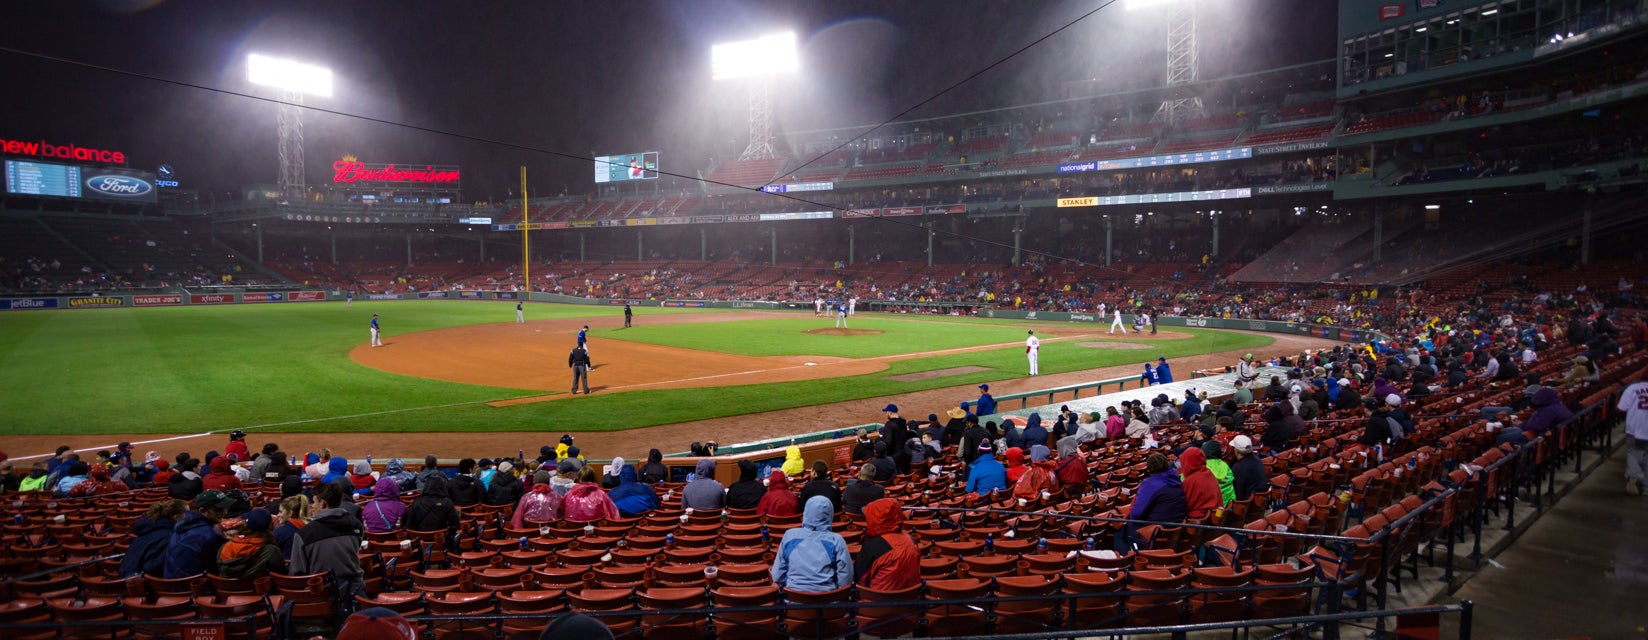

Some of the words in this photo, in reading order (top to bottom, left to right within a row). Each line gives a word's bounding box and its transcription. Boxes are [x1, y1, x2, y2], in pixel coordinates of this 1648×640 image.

[41, 140, 125, 164] balance
[1275, 144, 1297, 153] STREET
[333, 160, 461, 183] Budweiser
[1060, 162, 1095, 172] nationalgrid
[100, 176, 141, 194] Ford
[1062, 198, 1094, 206] STANLEY
[70, 297, 104, 306] GRANITE
[106, 296, 122, 305] CITY
[201, 294, 224, 303] xfinity
[11, 299, 45, 309] jetBlue
